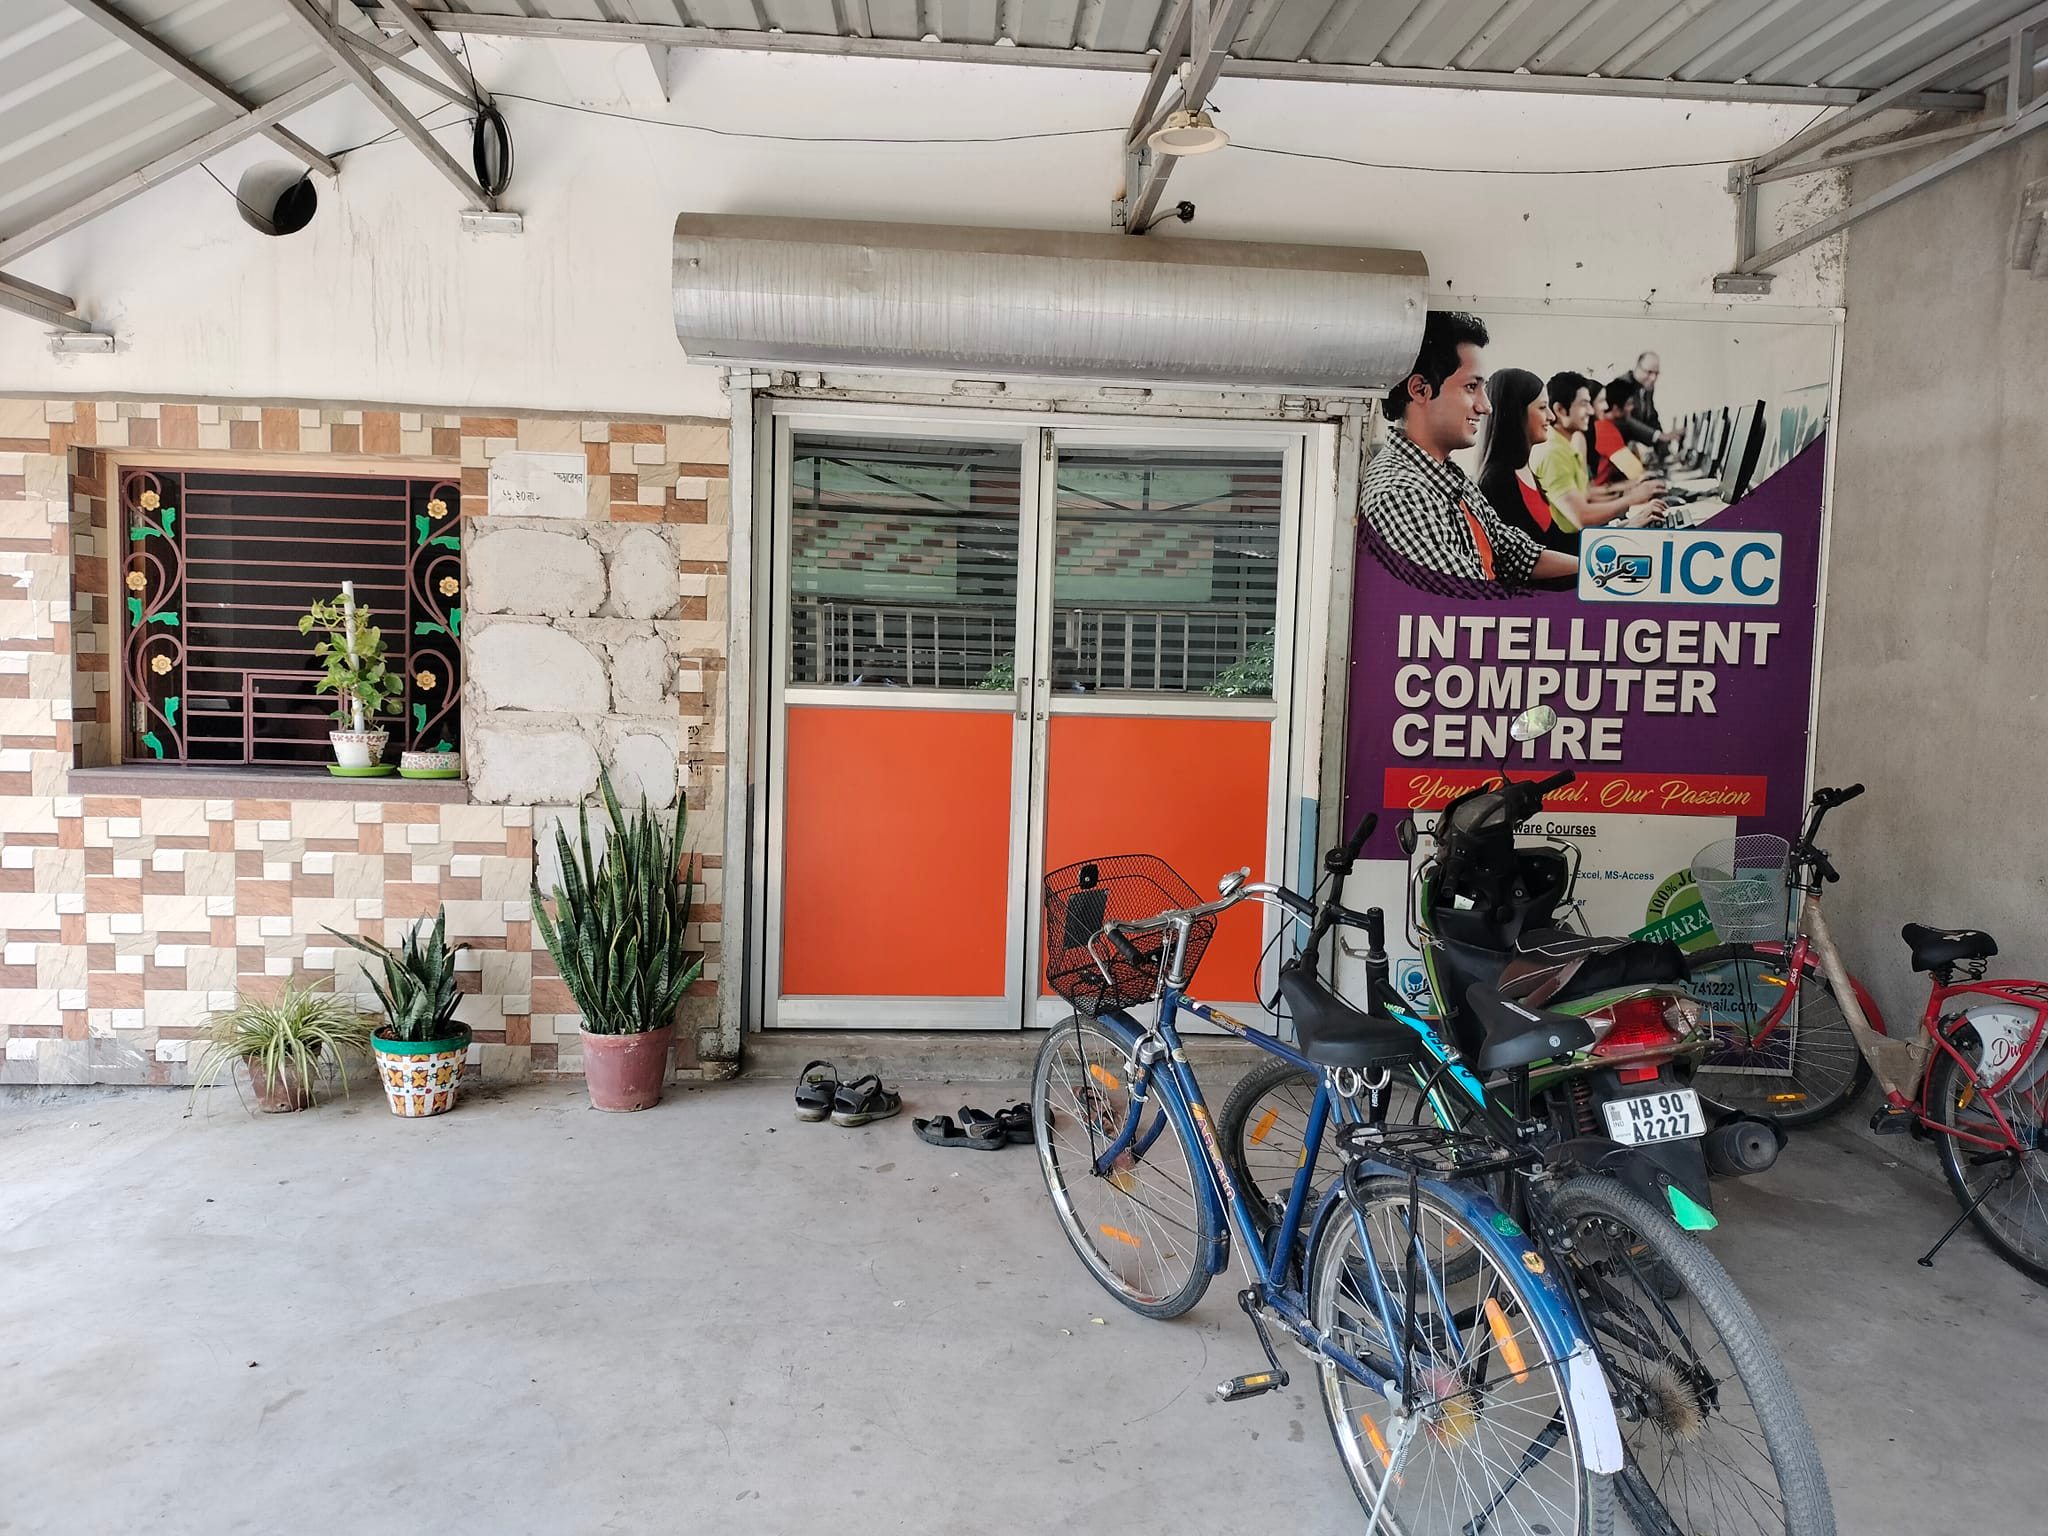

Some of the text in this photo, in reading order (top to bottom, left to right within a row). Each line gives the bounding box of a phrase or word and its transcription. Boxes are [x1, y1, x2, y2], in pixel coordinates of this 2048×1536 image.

[1660, 540, 1776, 596] ICC
[1398, 615, 1781, 666] INTELLIGENT
[1394, 664, 1717, 714] COMPUTER
[1599, 779, 1654, 808] Our
[1659, 780, 1752, 809] Passion
[1546, 821, 1597, 836] Courses
[1604, 870, 1655, 881] MS-Access
[1649, 882, 1679, 915] 100%
[1642, 908, 1713, 946] GUARA
[1691, 982, 1735, 996] 741222
[1627, 1093, 1684, 1121] WB 90
[1632, 1113, 1691, 1143] A2227
